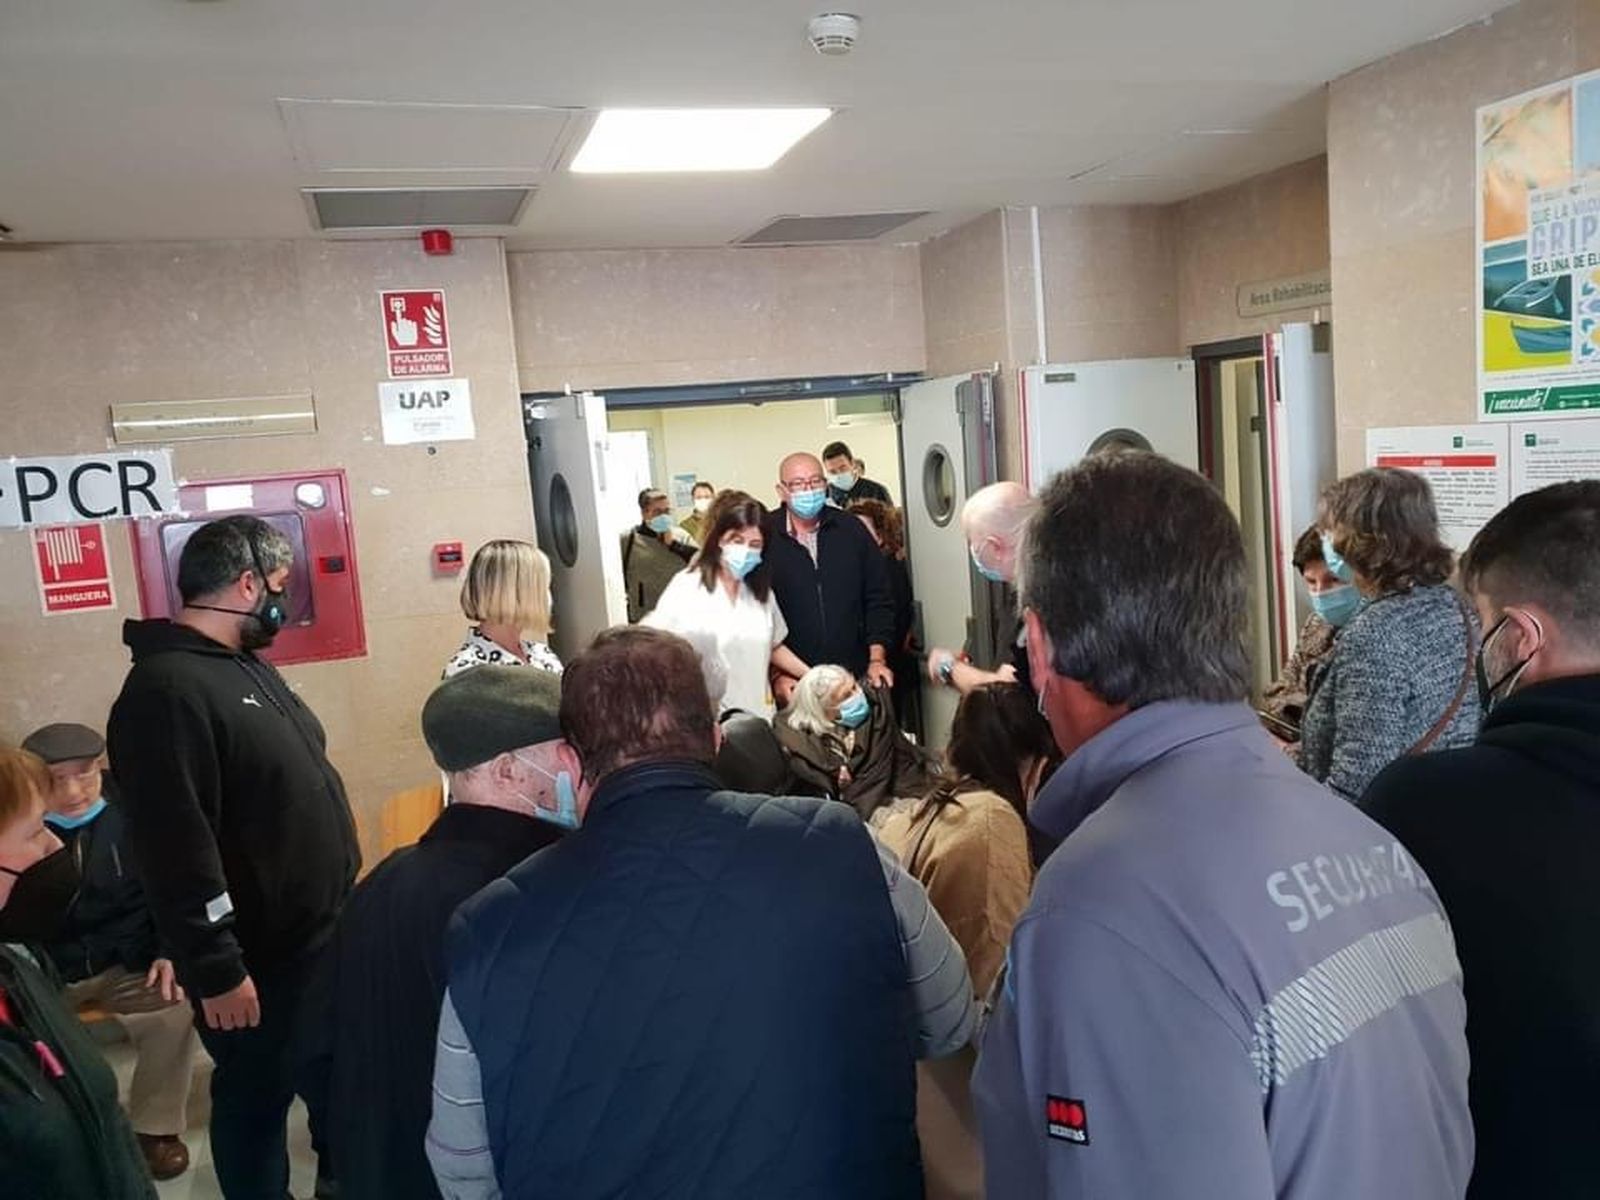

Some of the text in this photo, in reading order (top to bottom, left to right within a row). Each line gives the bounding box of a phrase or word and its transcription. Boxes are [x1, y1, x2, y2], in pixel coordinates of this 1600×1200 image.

[1532, 261, 1548, 276] SEA
[1551, 257, 1570, 272] UNA
[1573, 254, 1585, 269] DE
[393, 366, 407, 374] DE
[399, 390, 450, 409] UAP
[15, 460, 162, 523] PCR
[48, 590, 109, 604] MANGUERA
